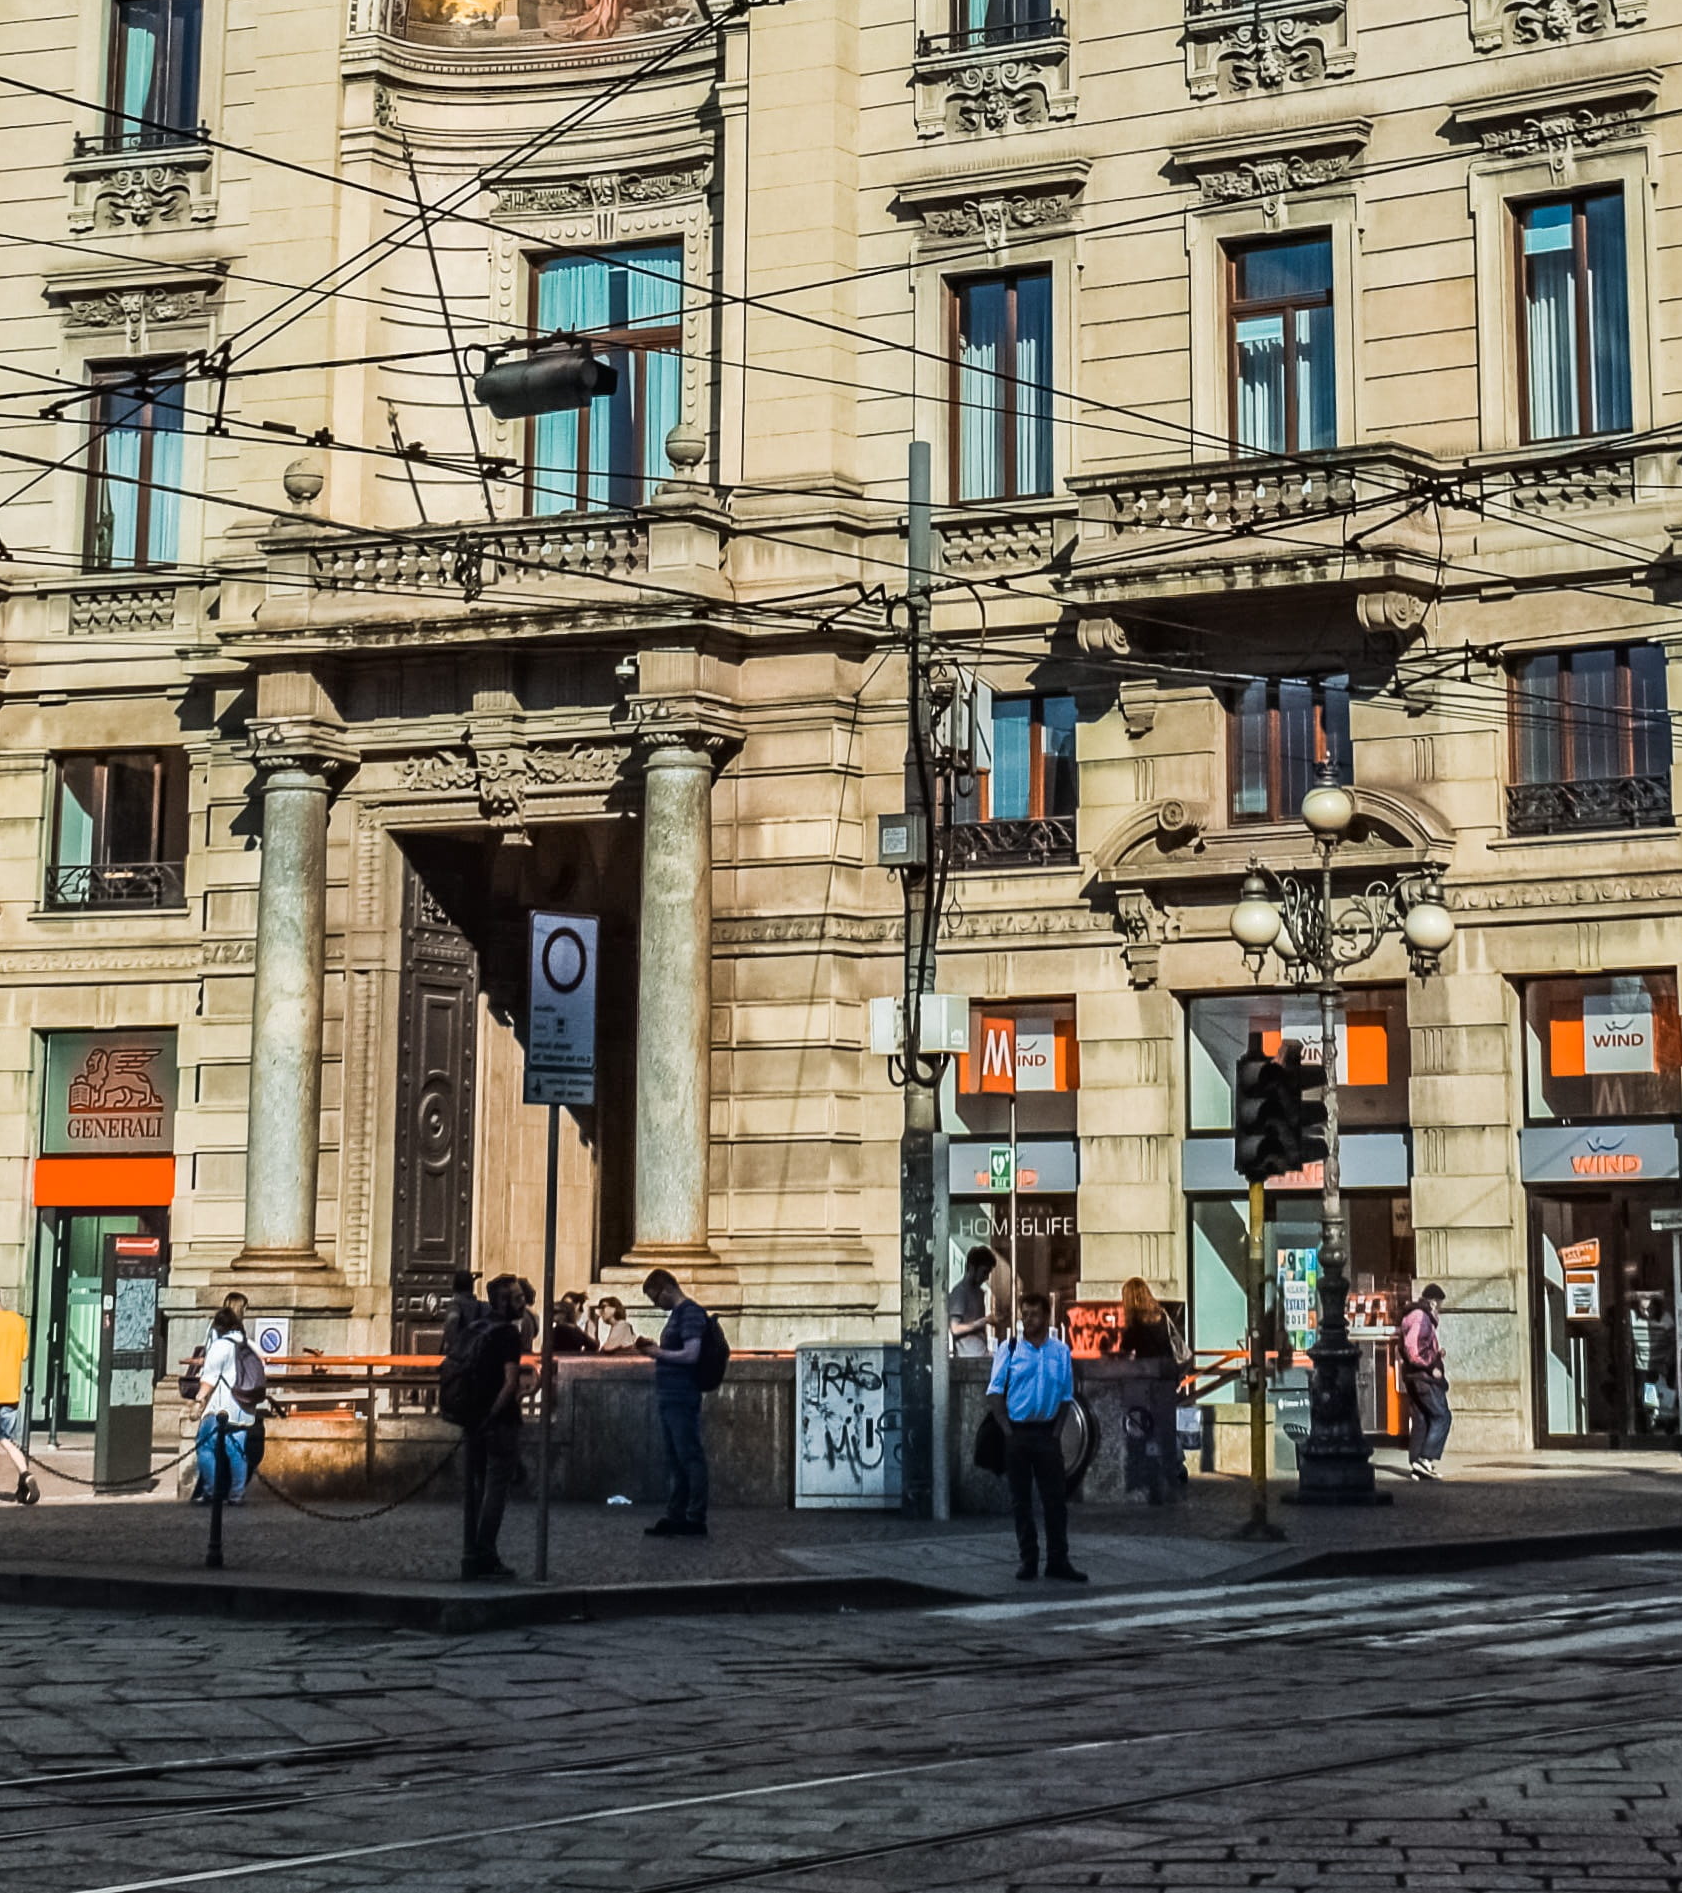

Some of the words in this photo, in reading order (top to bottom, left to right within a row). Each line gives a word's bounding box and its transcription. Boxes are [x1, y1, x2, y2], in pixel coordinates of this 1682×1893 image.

[1592, 1033, 1644, 1048] WIND
[982, 1028, 1013, 1078] M
[1015, 1054, 1047, 1067] IND
[67, 1117, 163, 1139] GENERALI
[1571, 1155, 1642, 1174] WIND
